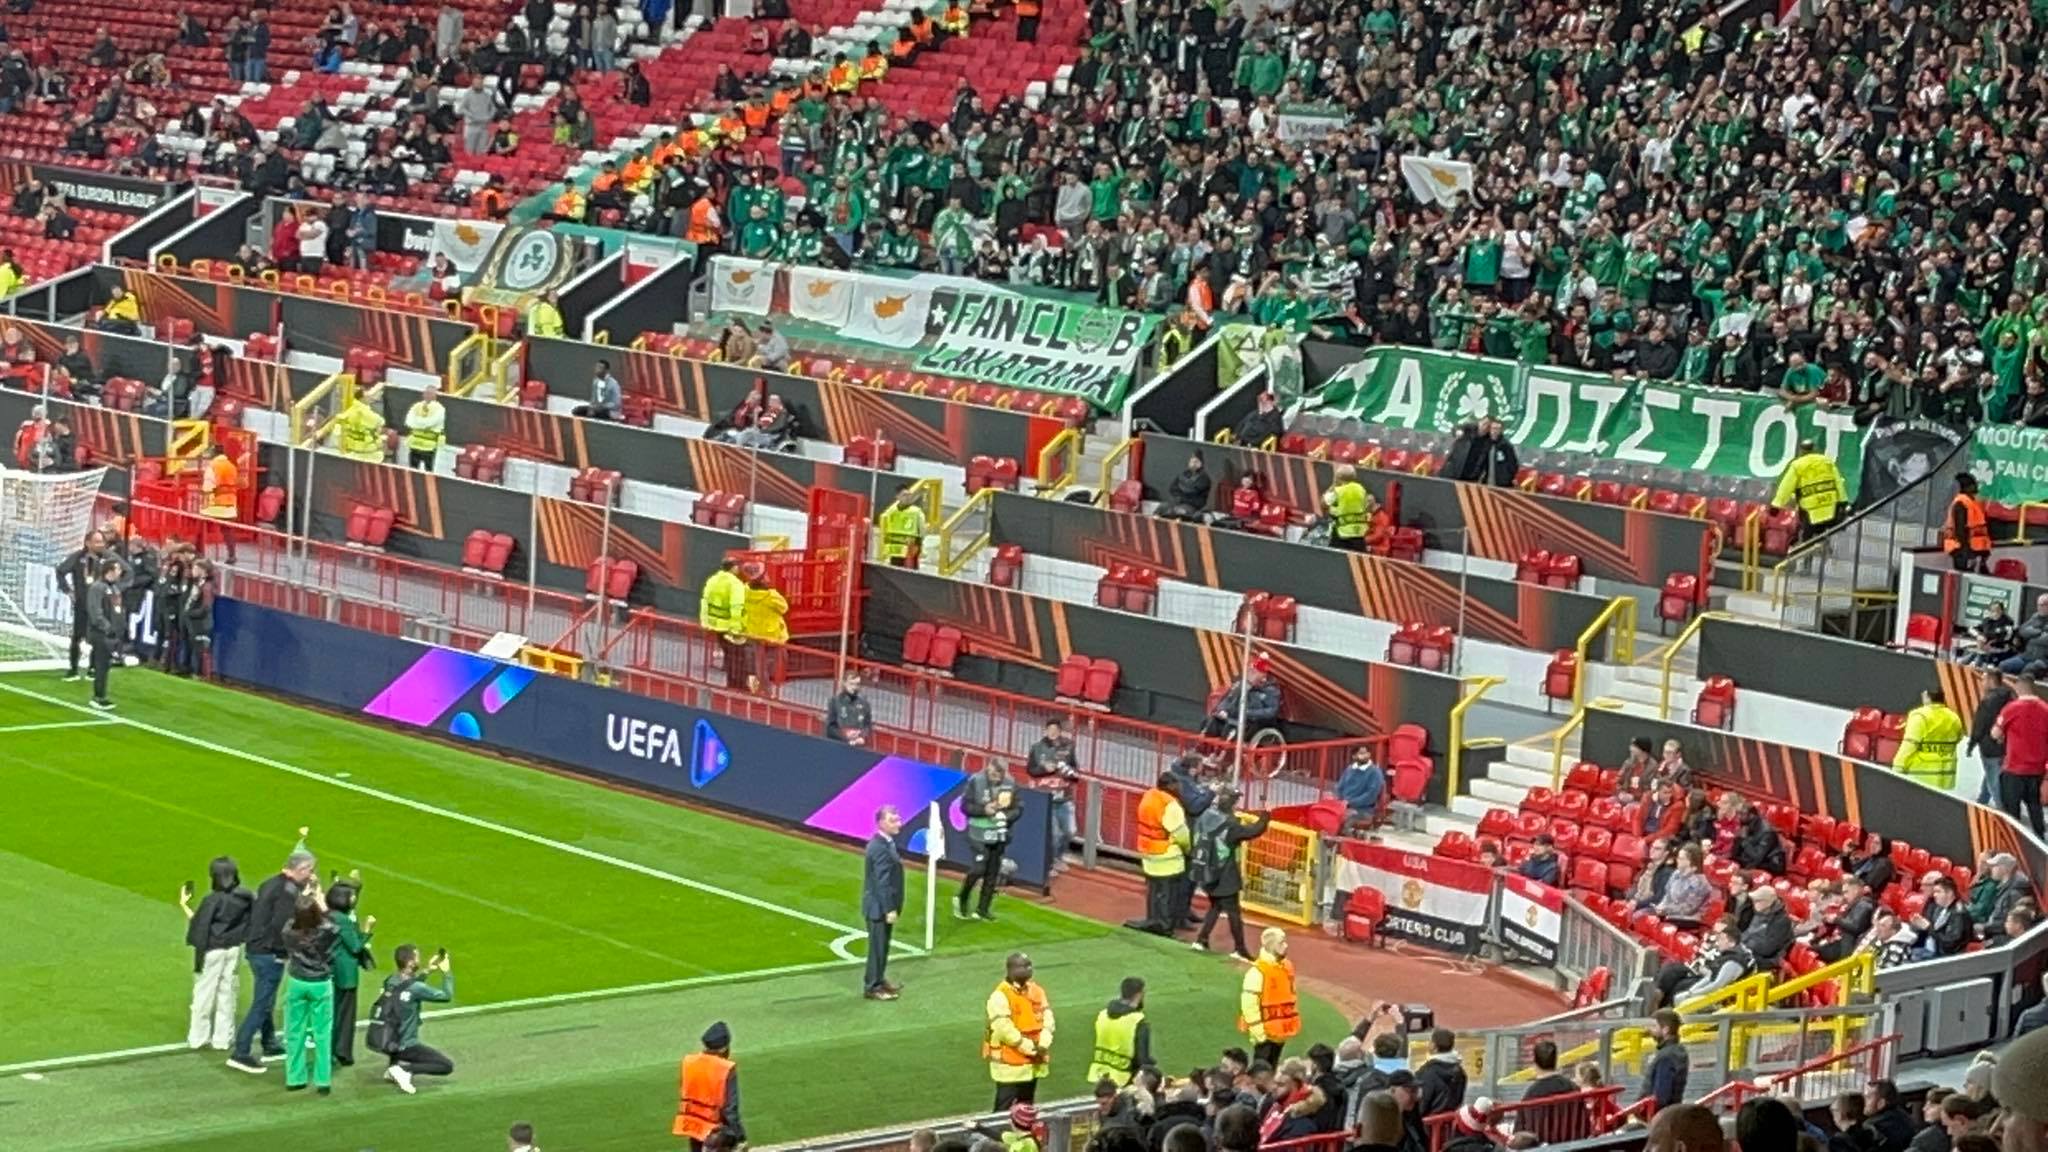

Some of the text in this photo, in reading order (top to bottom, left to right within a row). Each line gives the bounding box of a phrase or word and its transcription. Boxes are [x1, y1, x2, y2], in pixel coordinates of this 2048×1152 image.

[77, 184, 115, 203] EUROPA
[117, 190, 158, 208] LEAGUE
[950, 293, 1024, 342] FAN
[921, 343, 1121, 399] LAKATAMIA
[1995, 460, 2028, 479] FAN
[607, 713, 682, 767] UEFA
[1403, 855, 1428, 872] USA
[1434, 927, 1466, 945] CLUB
